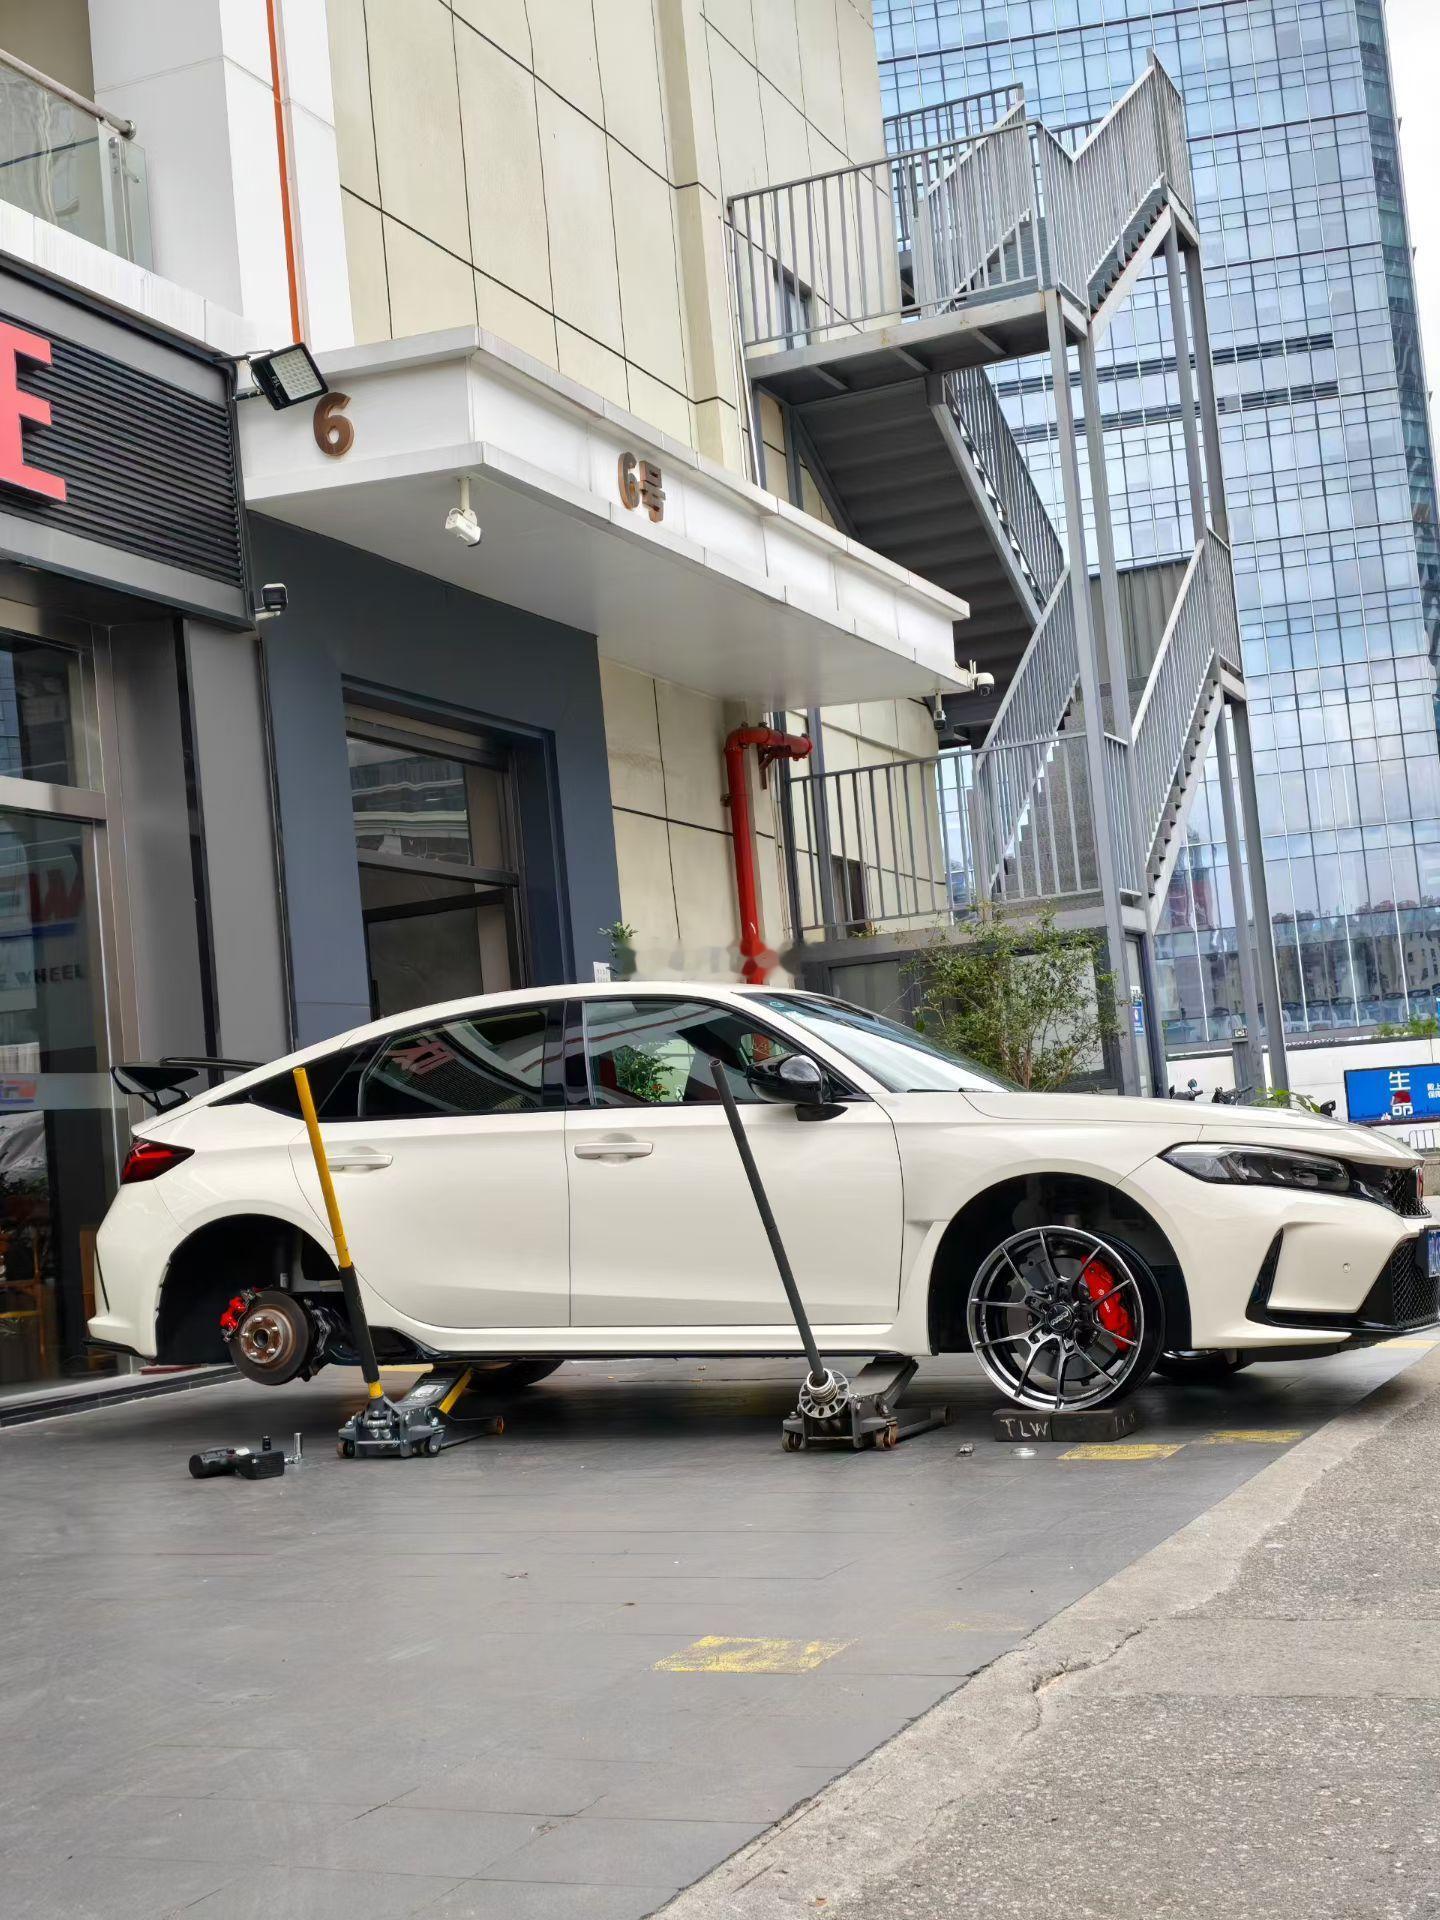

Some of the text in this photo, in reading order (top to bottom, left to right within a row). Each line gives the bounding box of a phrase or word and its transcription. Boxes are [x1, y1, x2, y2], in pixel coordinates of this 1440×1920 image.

[0, 321, 66, 501] E
[313, 391, 355, 457] 6
[618, 451, 666, 523] 6号
[1000, 1418, 1049, 1438] TLW
